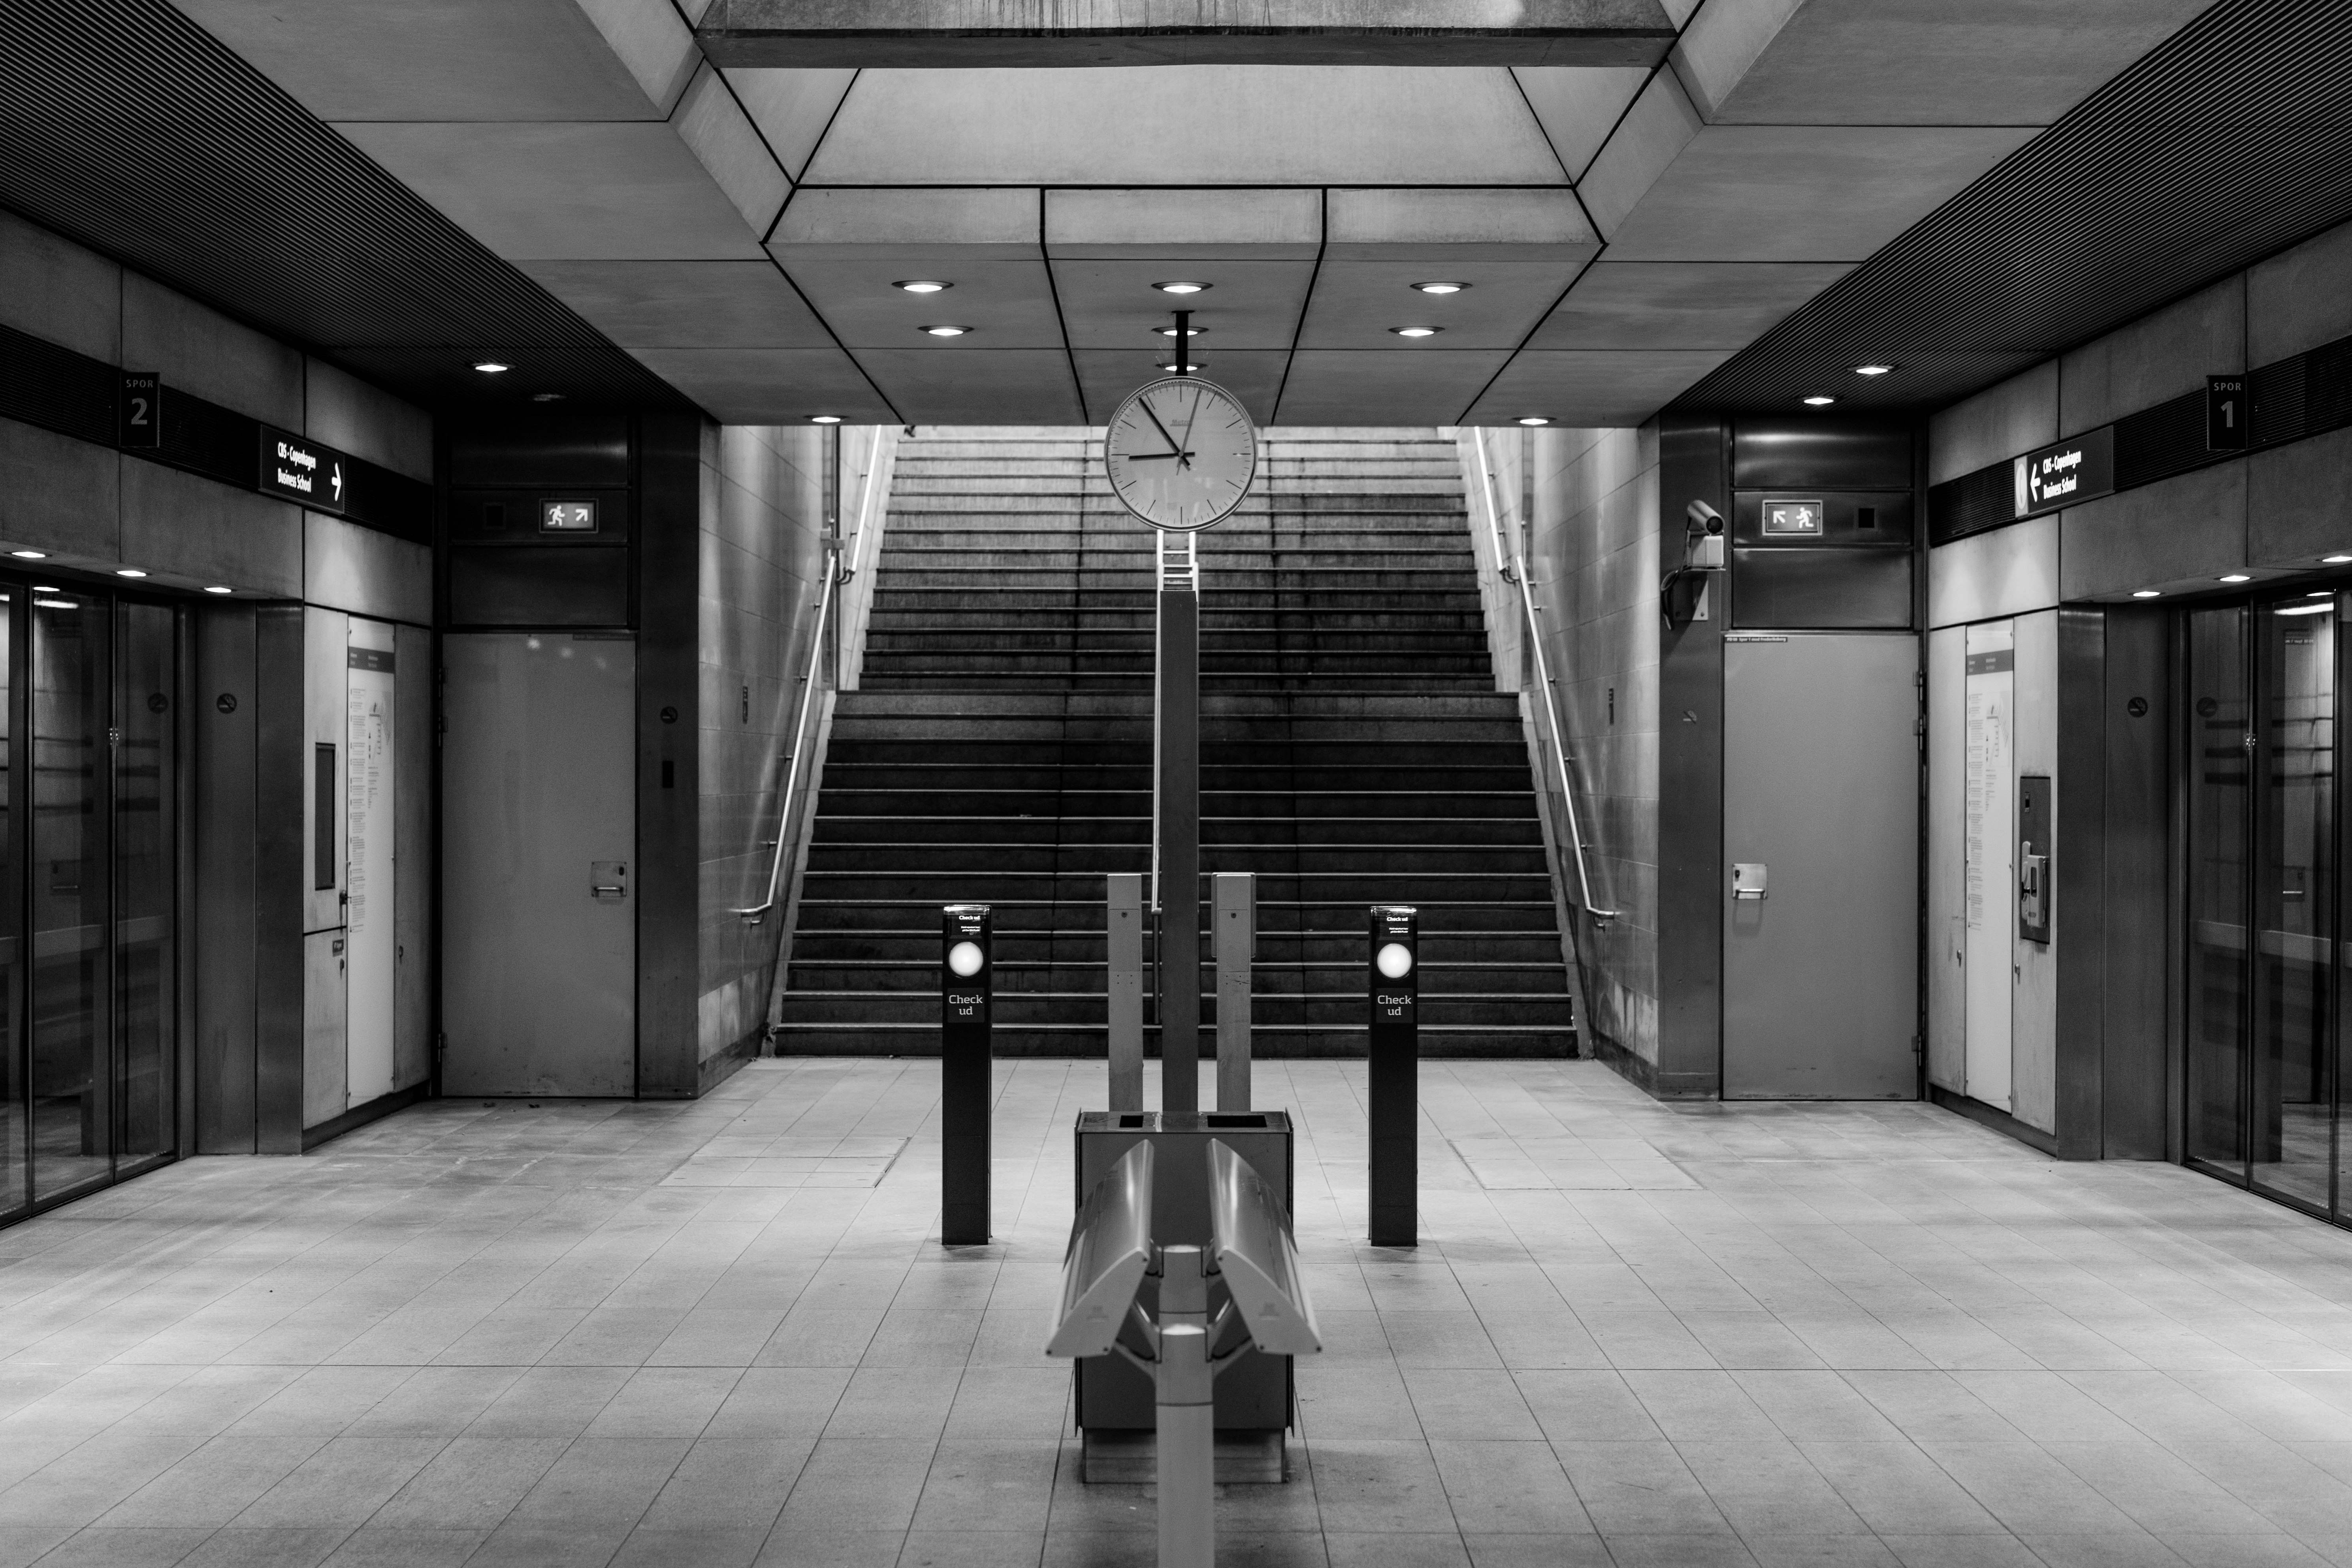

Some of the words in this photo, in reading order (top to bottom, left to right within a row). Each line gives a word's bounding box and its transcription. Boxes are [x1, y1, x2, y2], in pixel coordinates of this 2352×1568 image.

[126, 379, 153, 388] SPOR
[2213, 382, 2241, 391] SPOR
[131, 397, 148, 425] 2
[2220, 401, 2233, 428] 1
[278, 441, 287, 459] CBS
[290, 445, 316, 472] Copenhagen
[2043, 457, 2052, 474] CBS
[2054, 450, 2081, 473] Copenhagen
[278, 467, 297, 488] Business
[297, 474, 311, 493] School
[2043, 481, 2062, 500] Business
[2062, 474, 2077, 494] School
[949, 994, 983, 1004] Check
[1377, 995, 1412, 1004] Check
[959, 1006, 973, 1015] ud
[1387, 1006, 1402, 1016] ud
